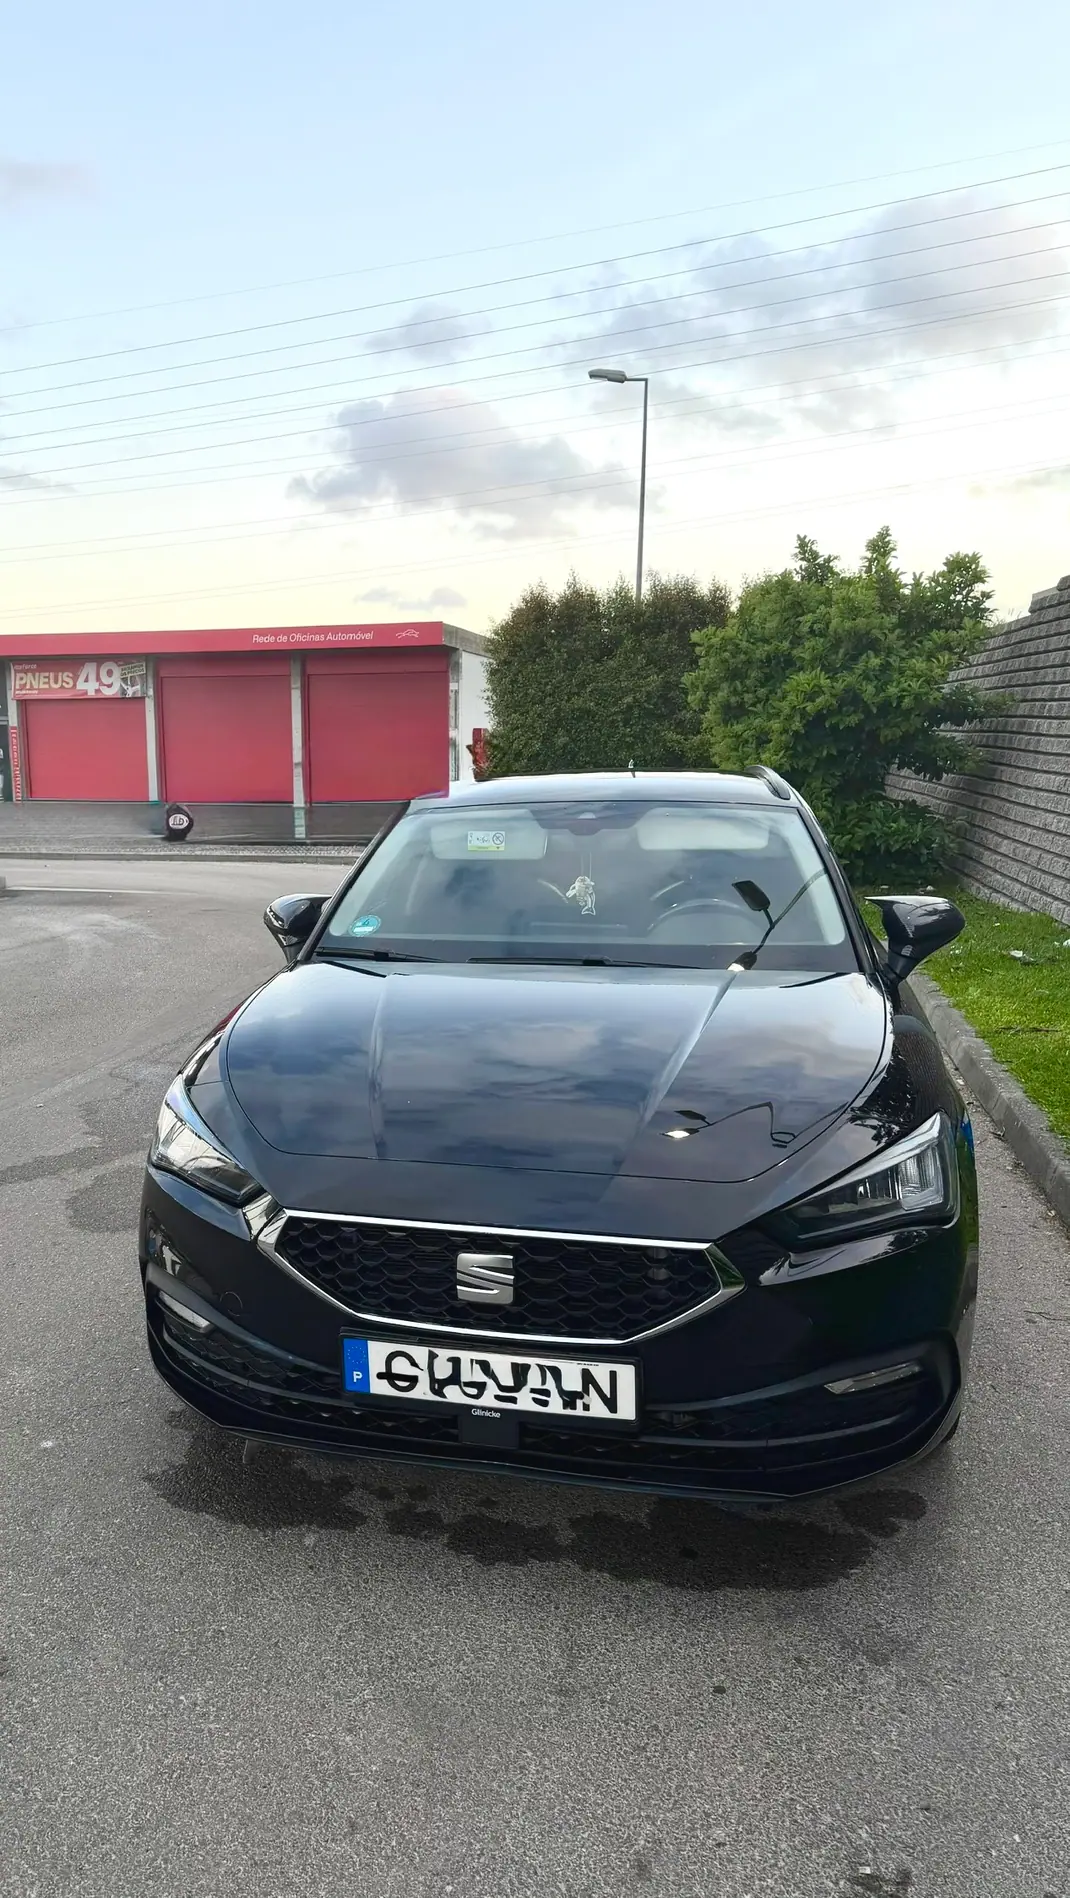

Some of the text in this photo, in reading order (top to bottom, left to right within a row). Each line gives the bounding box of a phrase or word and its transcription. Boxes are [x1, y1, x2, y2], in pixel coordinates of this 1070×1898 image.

[252, 630, 374, 643] Rede de Oficinas Automóvel
[15, 671, 74, 689] PNEUS
[76, 661, 121, 696] 49
[353, 1371, 363, 1382] P
[471, 1408, 501, 1418] Glinicke
